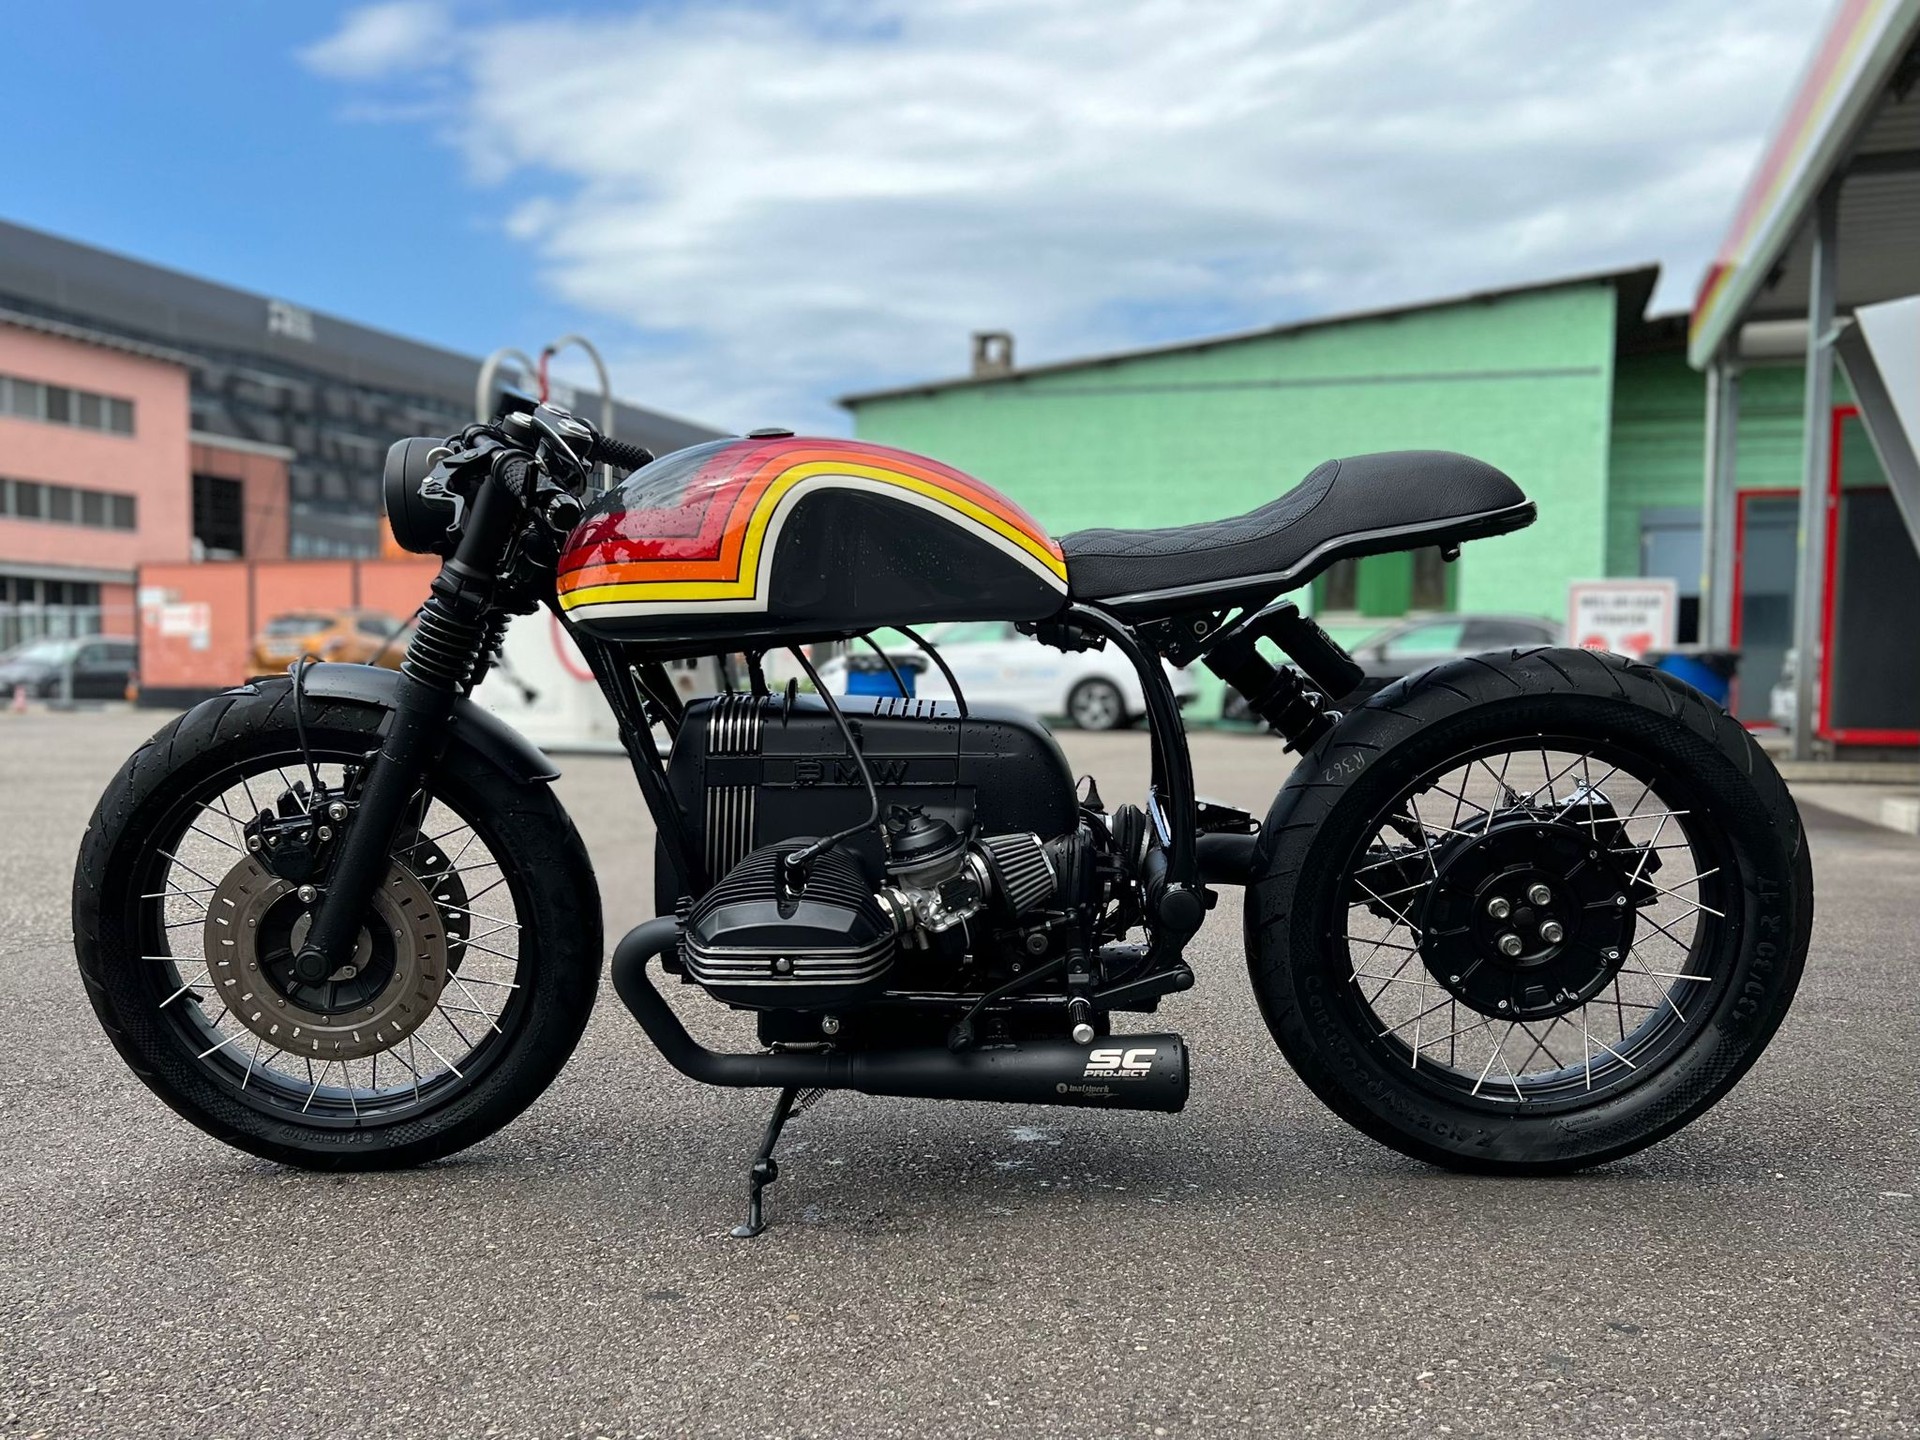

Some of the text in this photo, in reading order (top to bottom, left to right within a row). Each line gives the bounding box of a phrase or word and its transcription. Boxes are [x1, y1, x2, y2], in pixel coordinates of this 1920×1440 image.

[795, 760, 909, 784] BMW
[1085, 1048, 1157, 1069] SC
[1083, 1069, 1150, 1077] PROJECT
